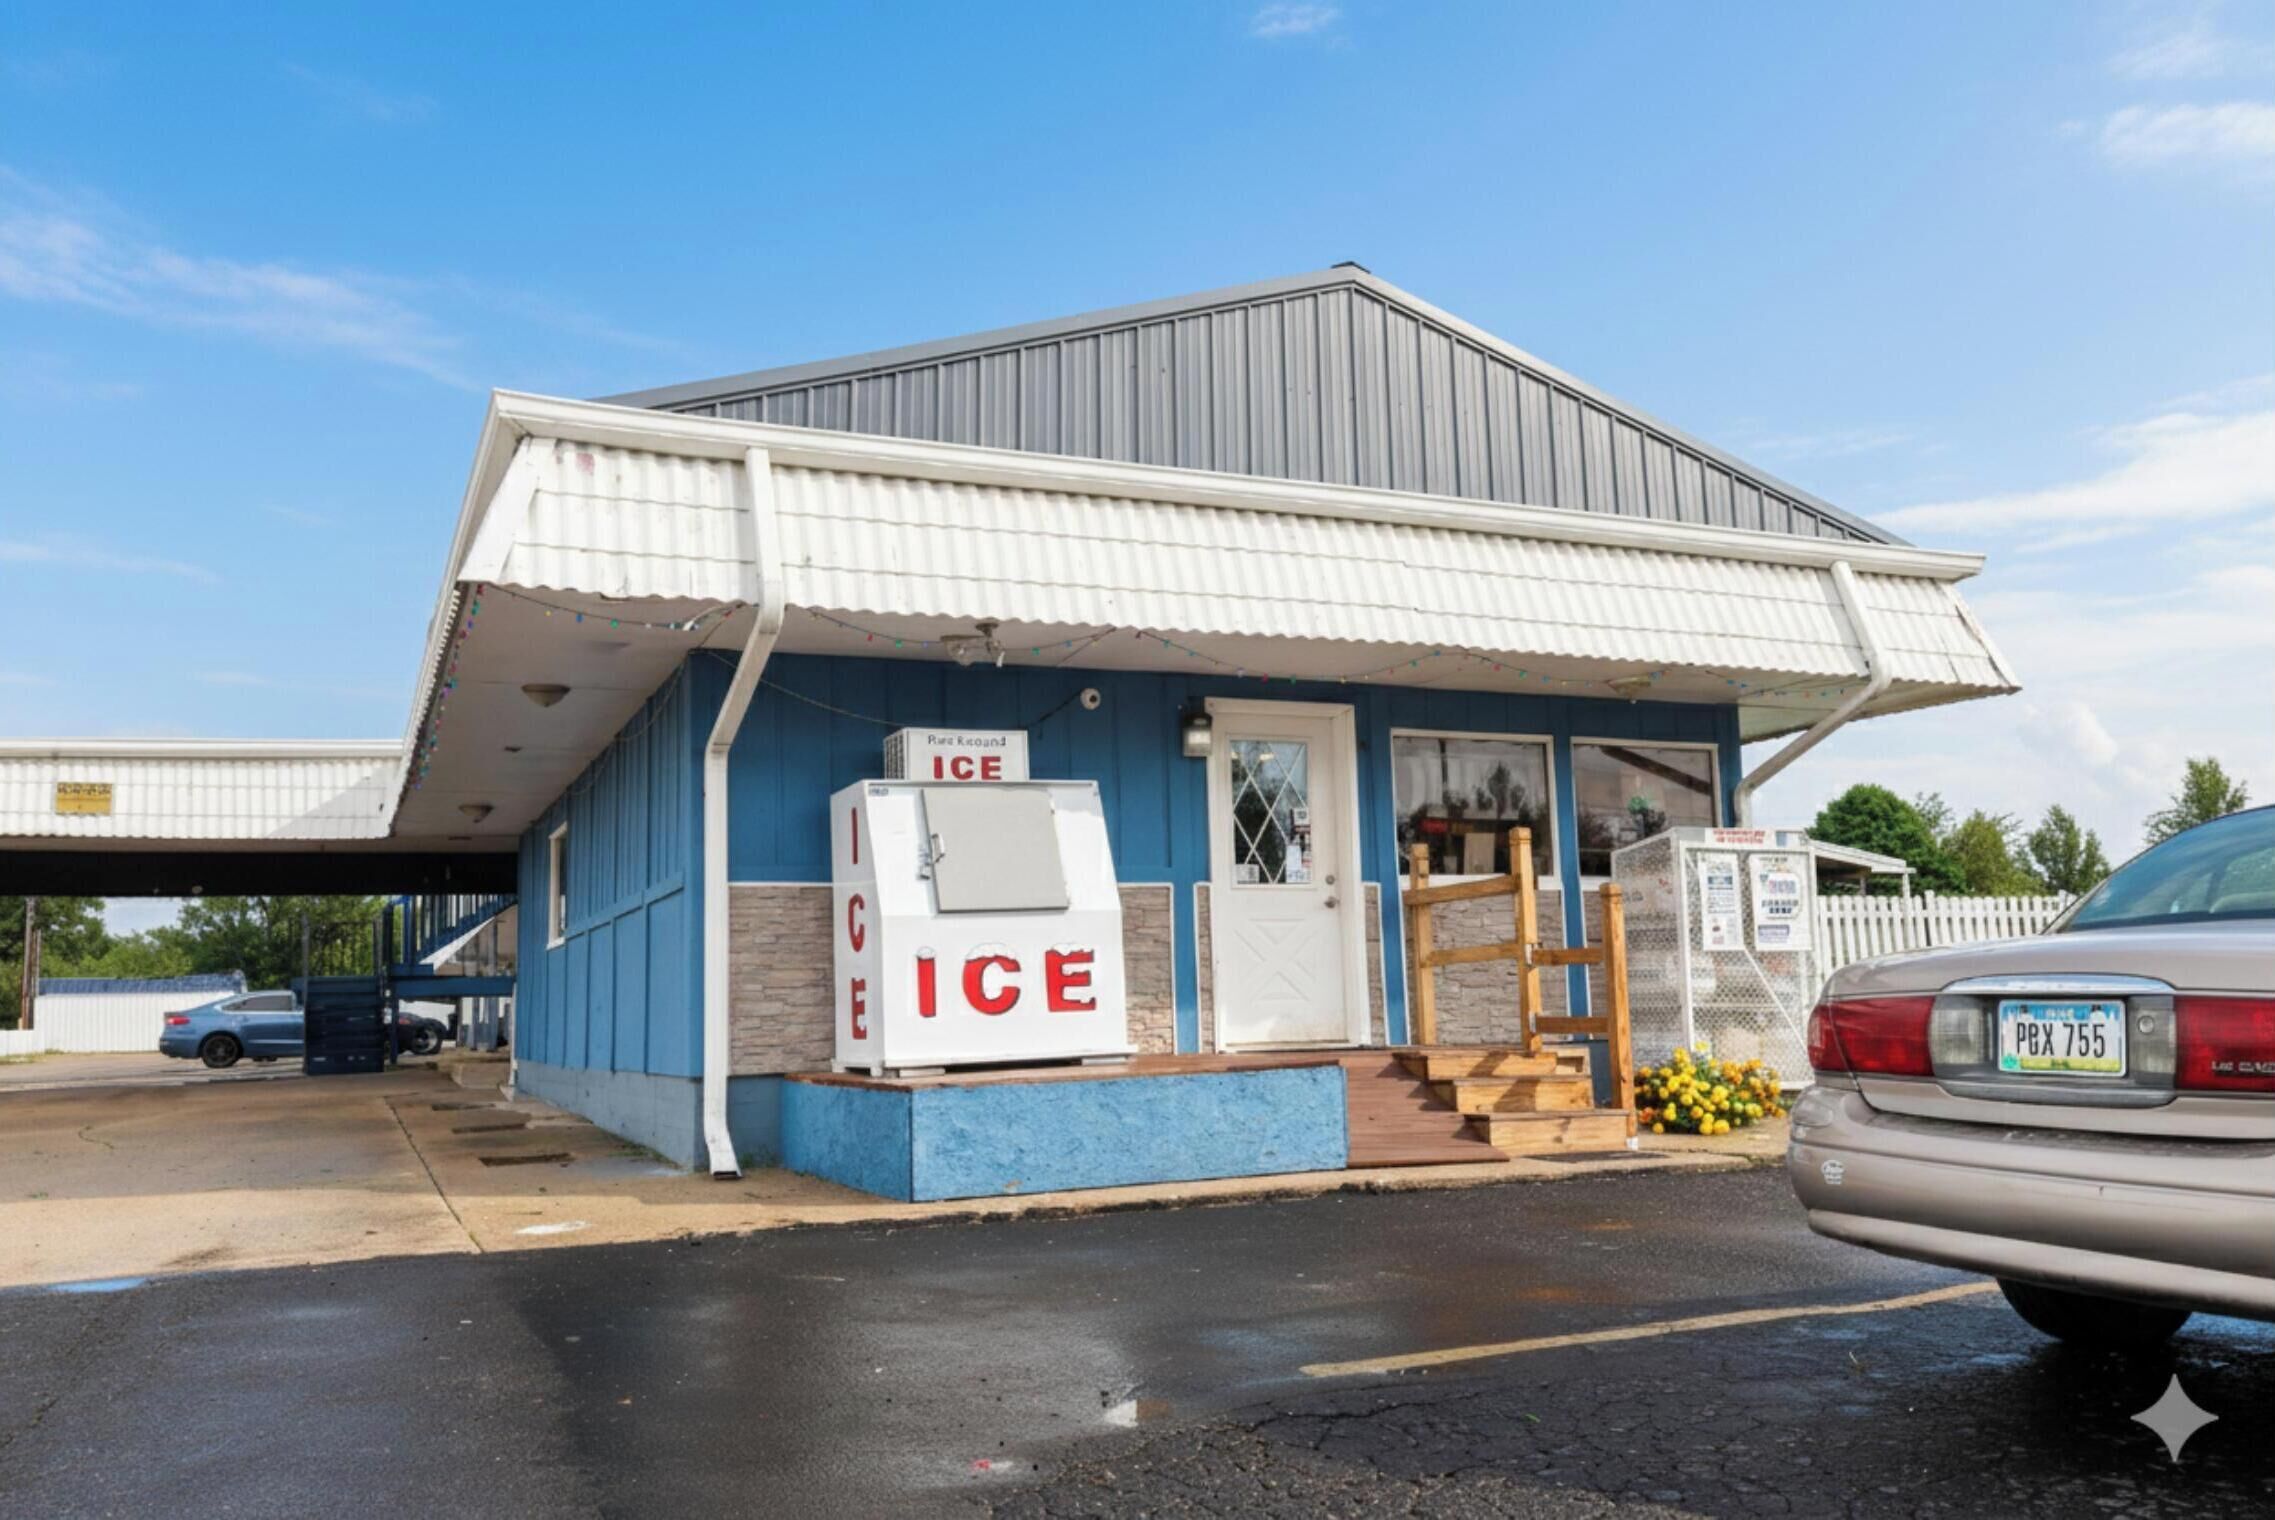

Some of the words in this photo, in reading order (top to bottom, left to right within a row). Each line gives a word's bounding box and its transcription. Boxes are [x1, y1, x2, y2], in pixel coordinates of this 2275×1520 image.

[933, 755, 1002, 781] ICE
[847, 807, 868, 1040] ICE
[914, 944, 1097, 1018] ICE
[2063, 1023, 2106, 1058] 755
